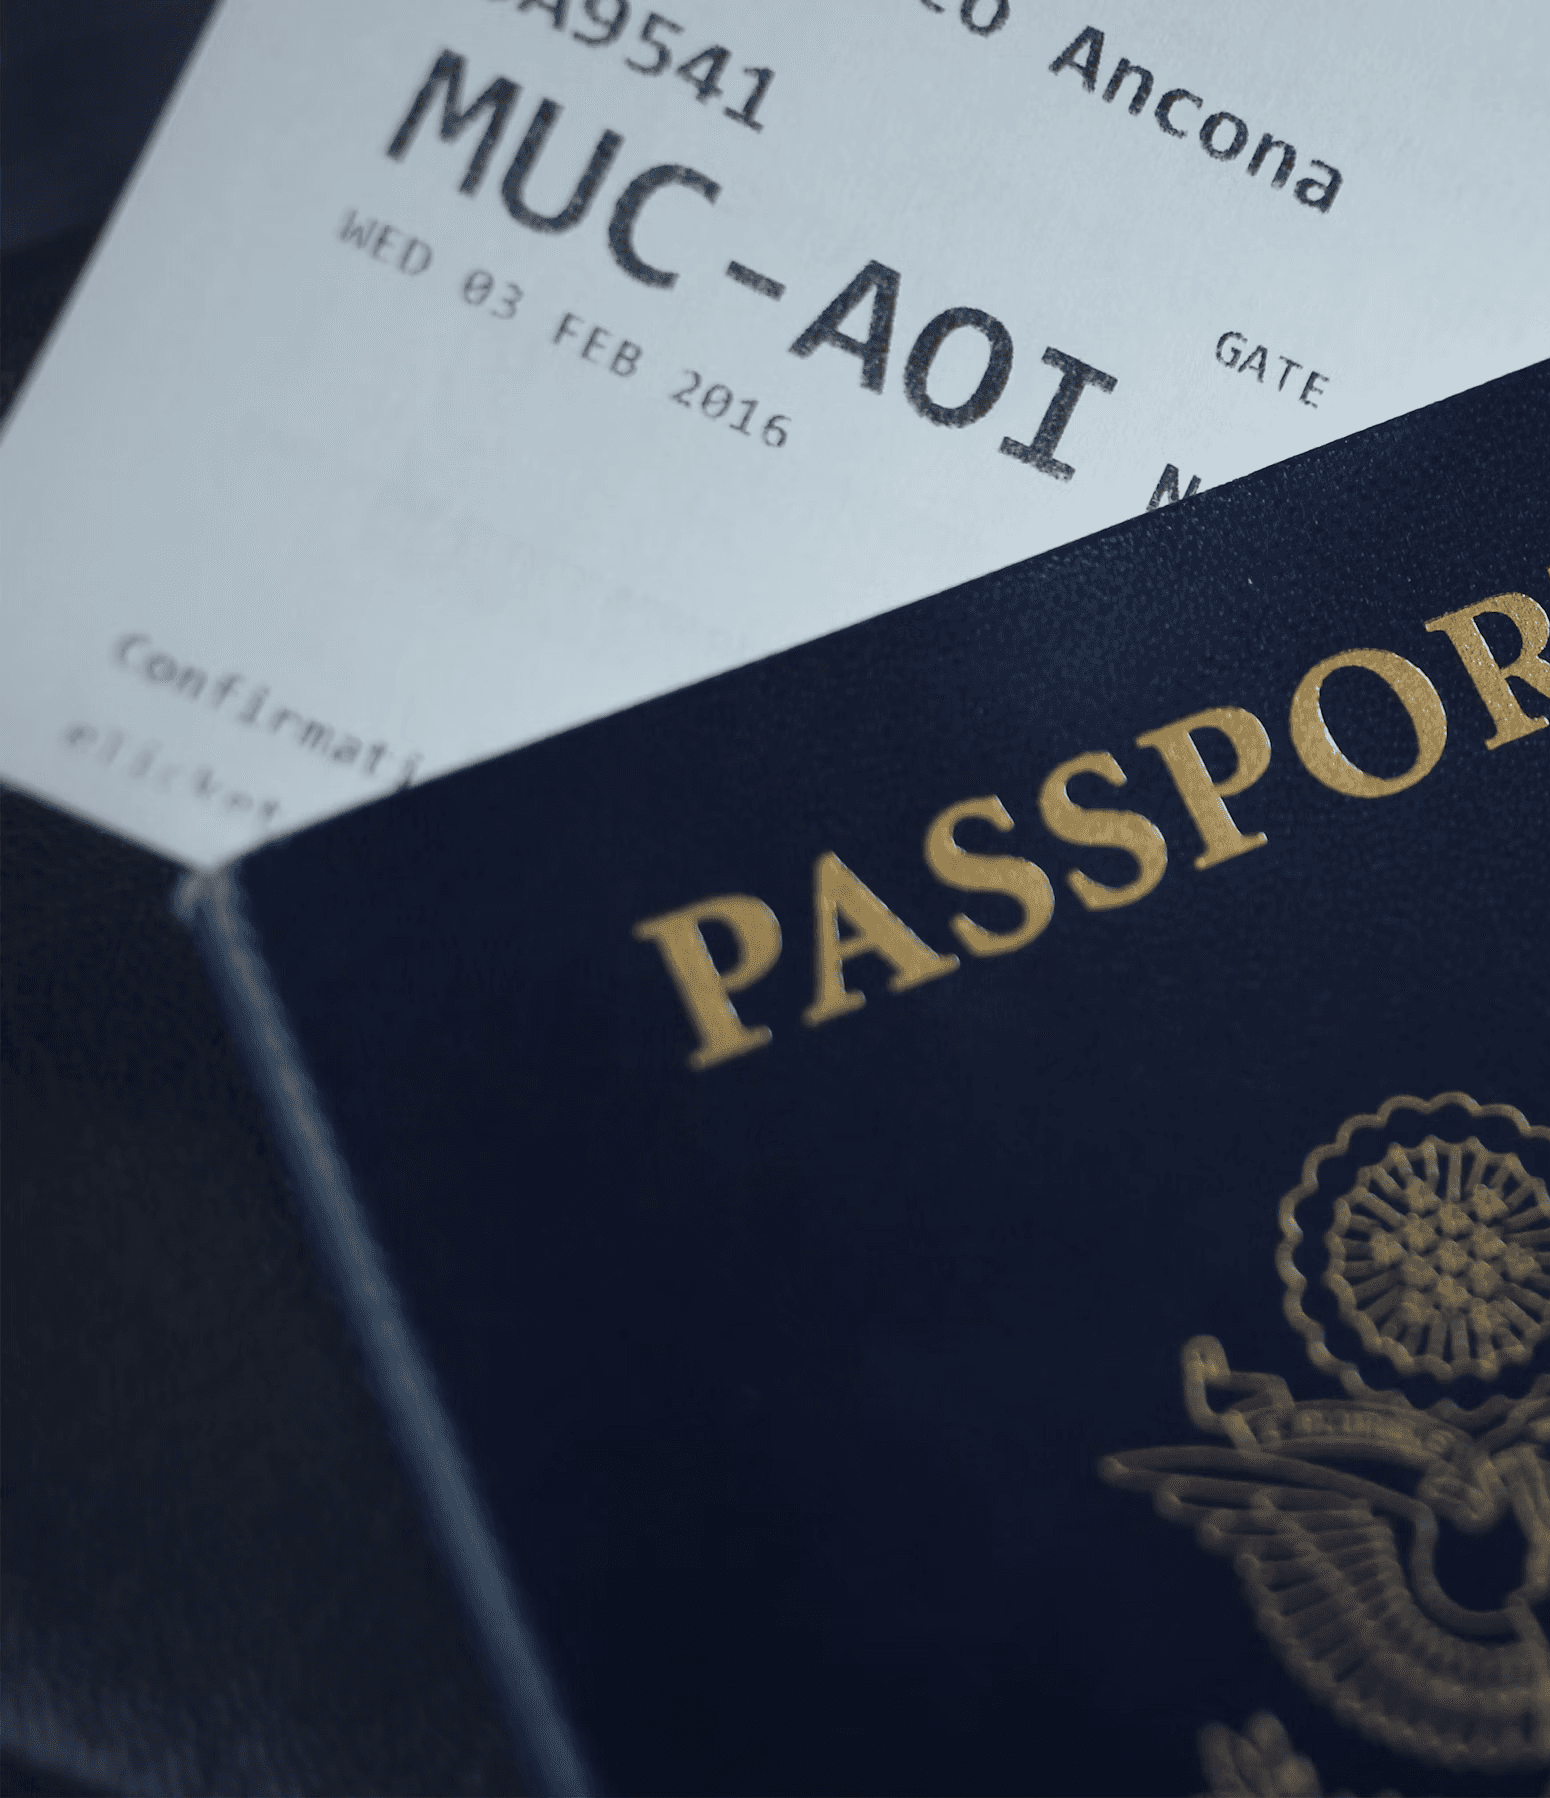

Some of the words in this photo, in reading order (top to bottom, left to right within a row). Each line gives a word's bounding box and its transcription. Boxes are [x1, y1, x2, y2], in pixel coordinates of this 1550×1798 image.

[1047, 25, 1345, 214] Ancona
[338, 208, 433, 277] WED
[461, 269, 525, 321] 03
[552, 311, 644, 379] FEB
[670, 370, 793, 449] 2016
[385, 47, 1119, 484] MUC-AOI
[1214, 329, 1331, 409] GATE
